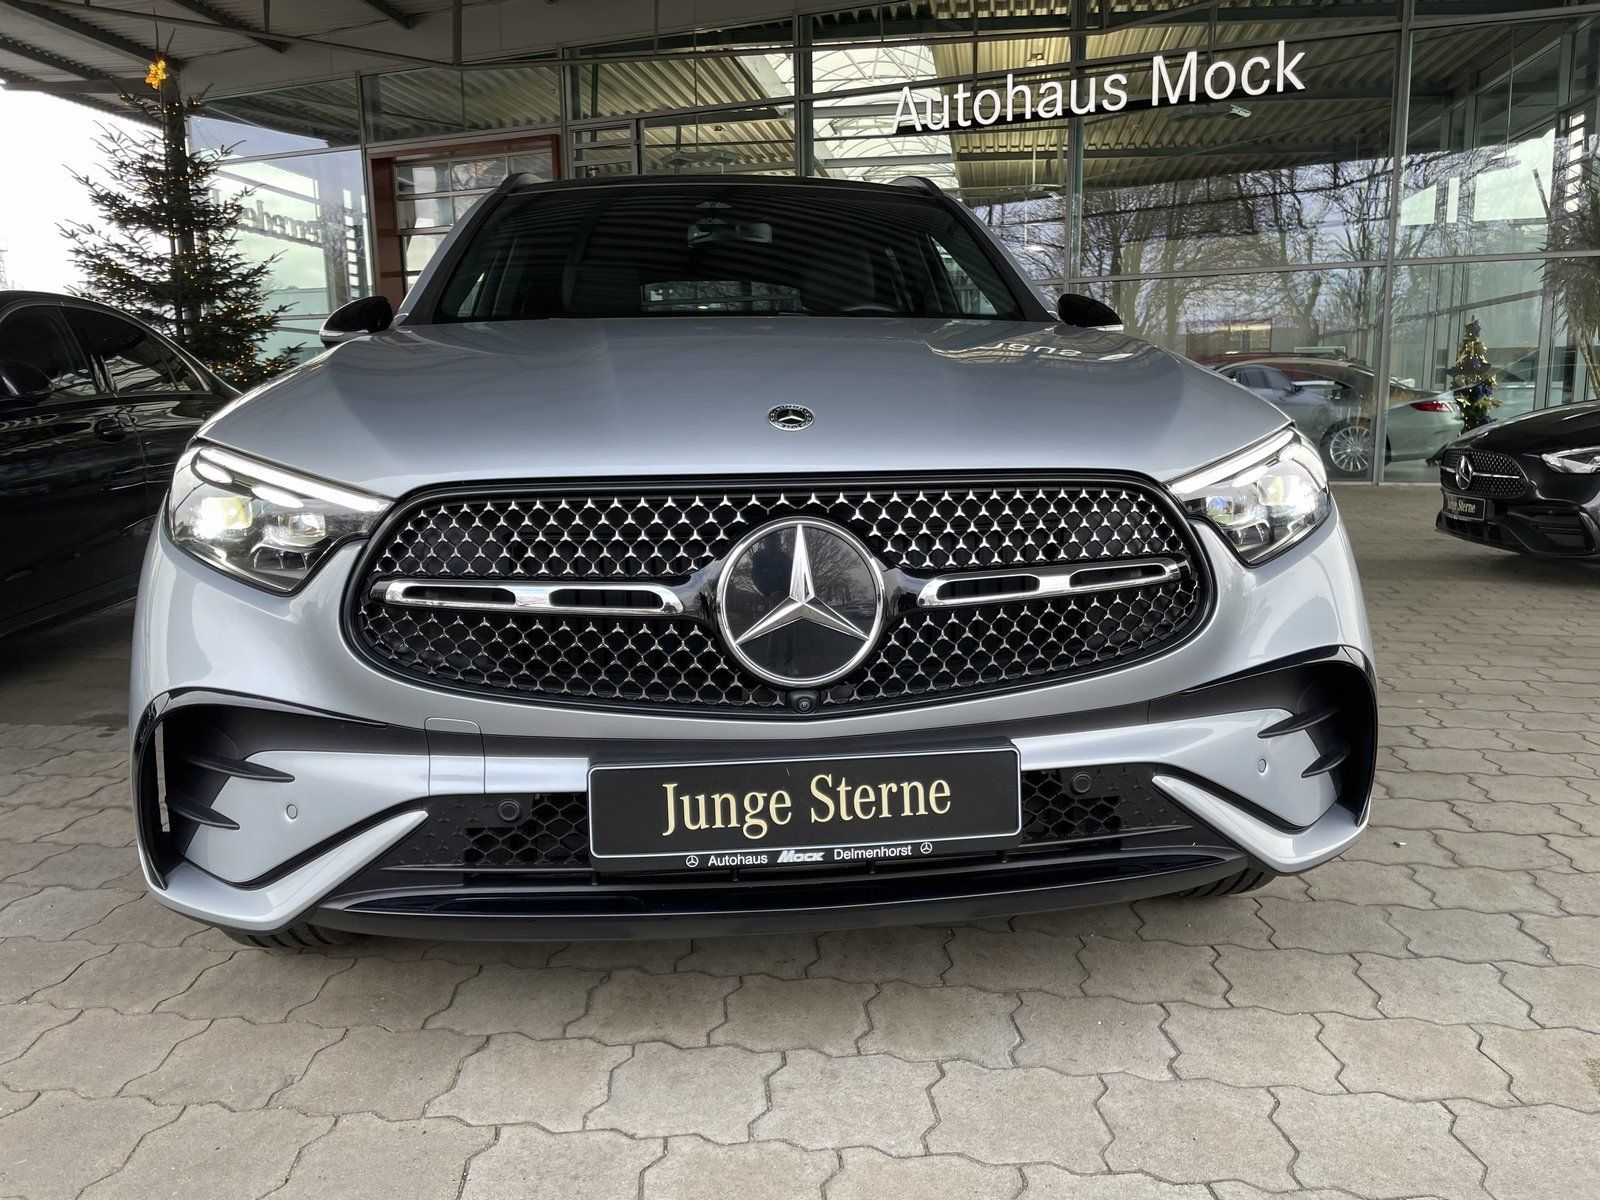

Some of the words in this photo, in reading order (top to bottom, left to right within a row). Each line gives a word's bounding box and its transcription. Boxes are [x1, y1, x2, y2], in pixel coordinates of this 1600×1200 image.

[891, 73, 1128, 135] Autohaus
[1151, 40, 1306, 107] Mock
[661, 783, 792, 840] Junge
[810, 773, 952, 824] Sterne
[707, 853, 768, 868] Autohaus
[833, 845, 912, 860] Delmenhorst
